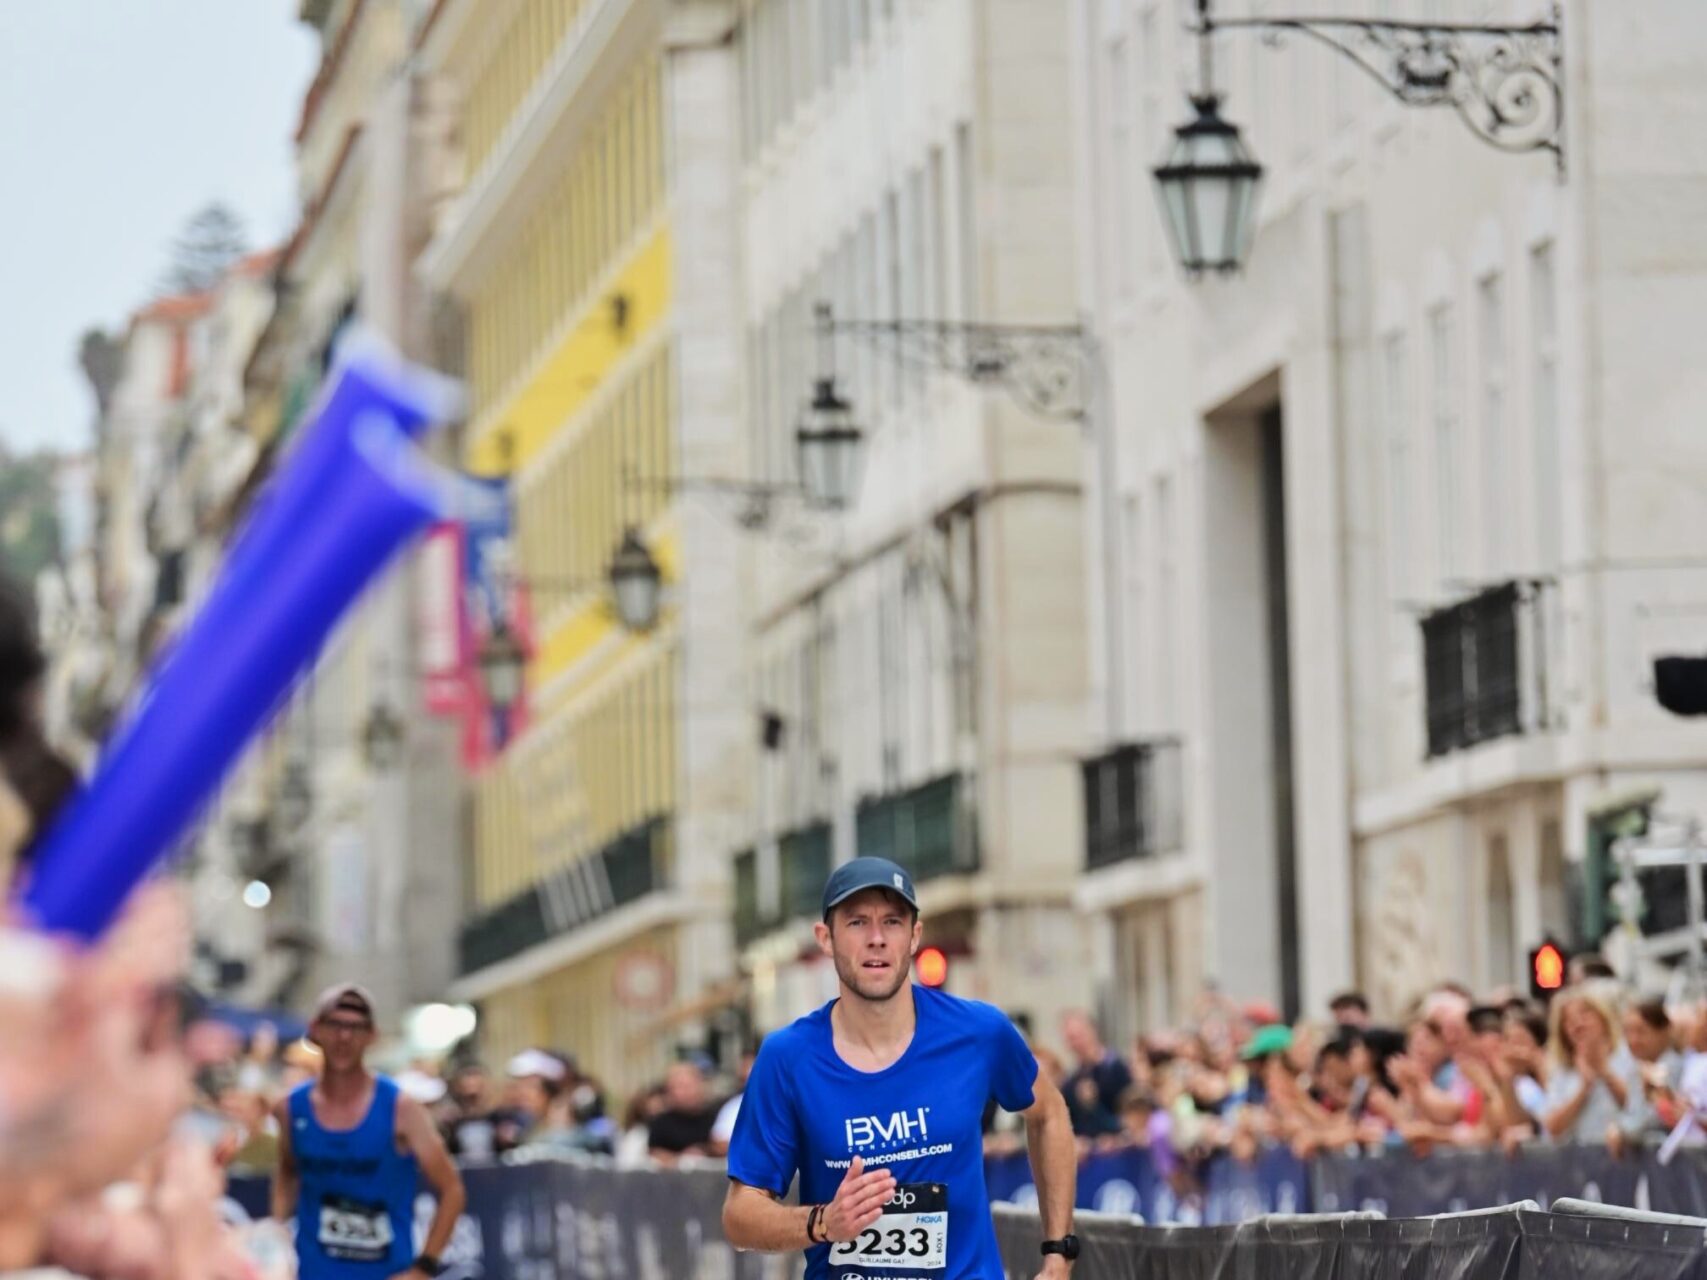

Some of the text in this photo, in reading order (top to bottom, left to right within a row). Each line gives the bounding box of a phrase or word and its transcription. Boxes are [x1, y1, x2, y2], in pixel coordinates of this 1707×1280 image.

[845, 1107, 928, 1147] BMH
[824, 1143, 953, 1169] WWWMHCONSEILS.COM
[883, 1187, 916, 1210] dp
[915, 1215, 943, 1225] HOKA
